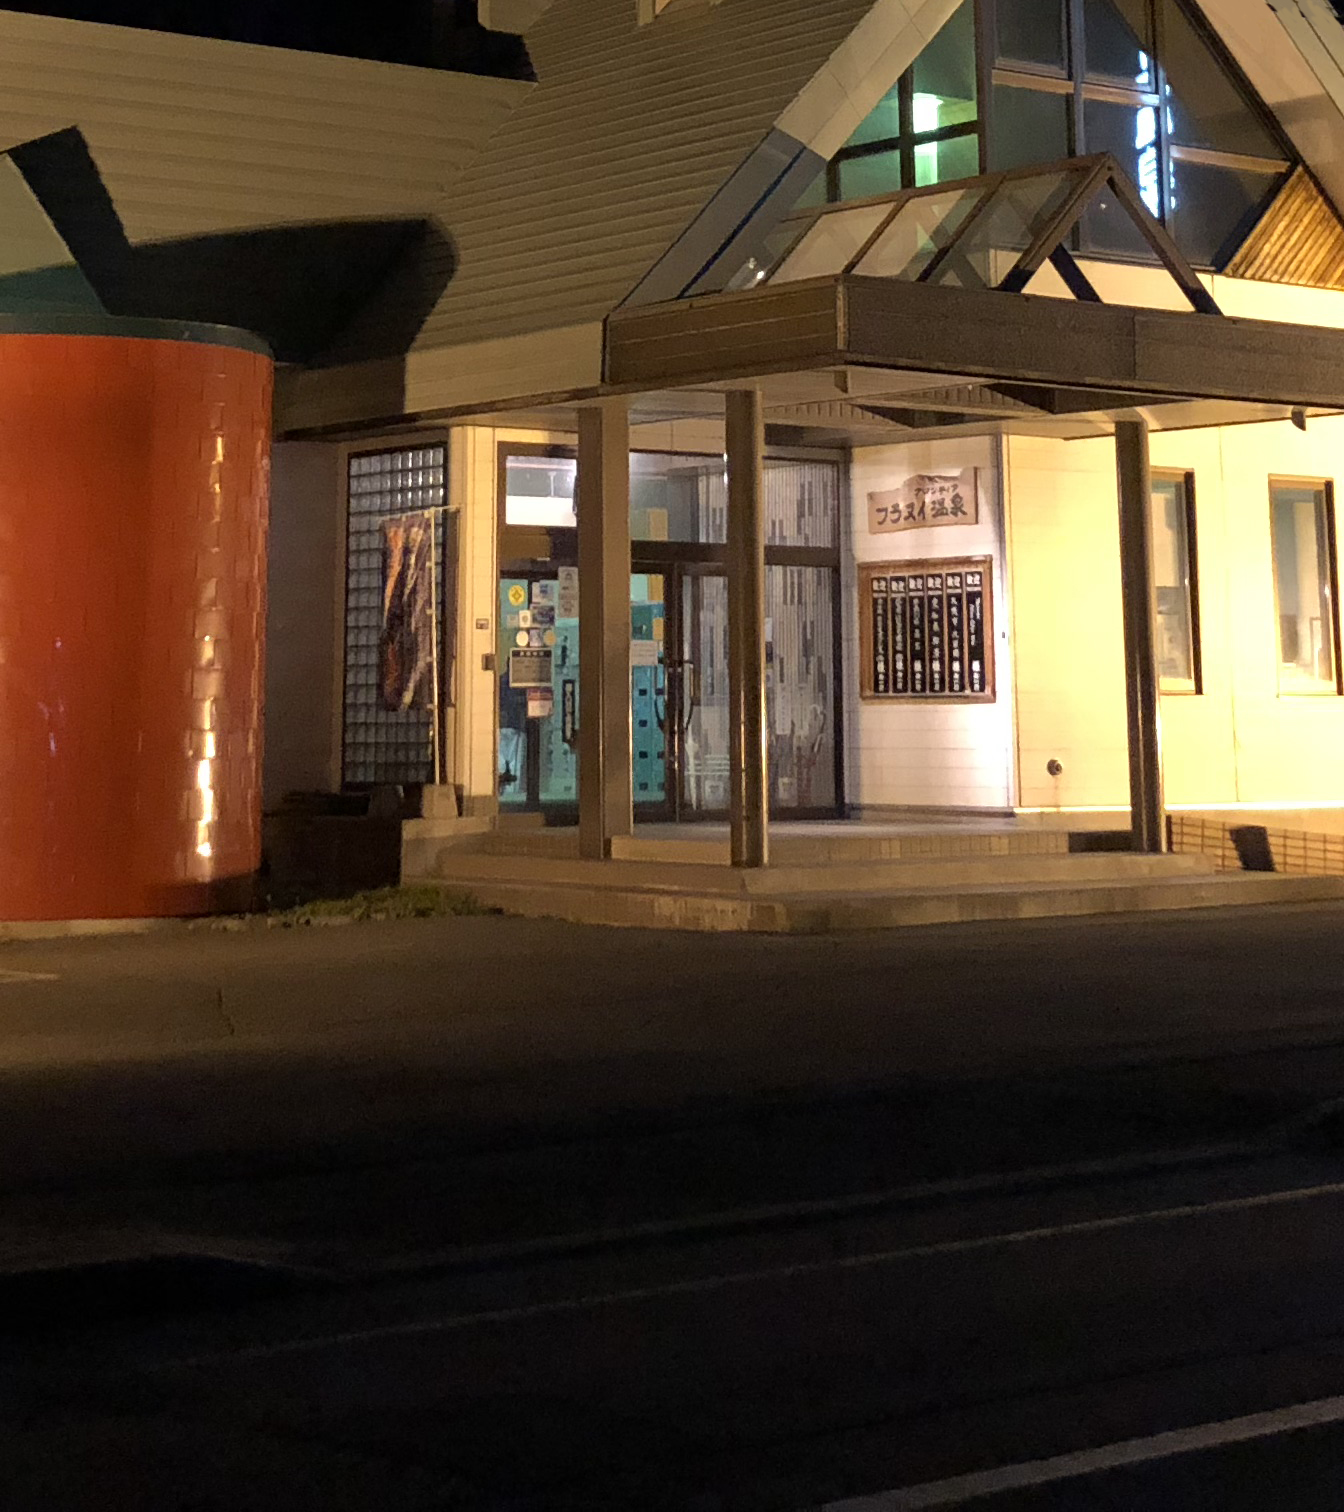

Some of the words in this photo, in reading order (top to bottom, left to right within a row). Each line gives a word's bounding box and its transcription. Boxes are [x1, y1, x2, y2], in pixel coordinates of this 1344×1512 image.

[875, 492, 968, 526] フラヌイ温泉
